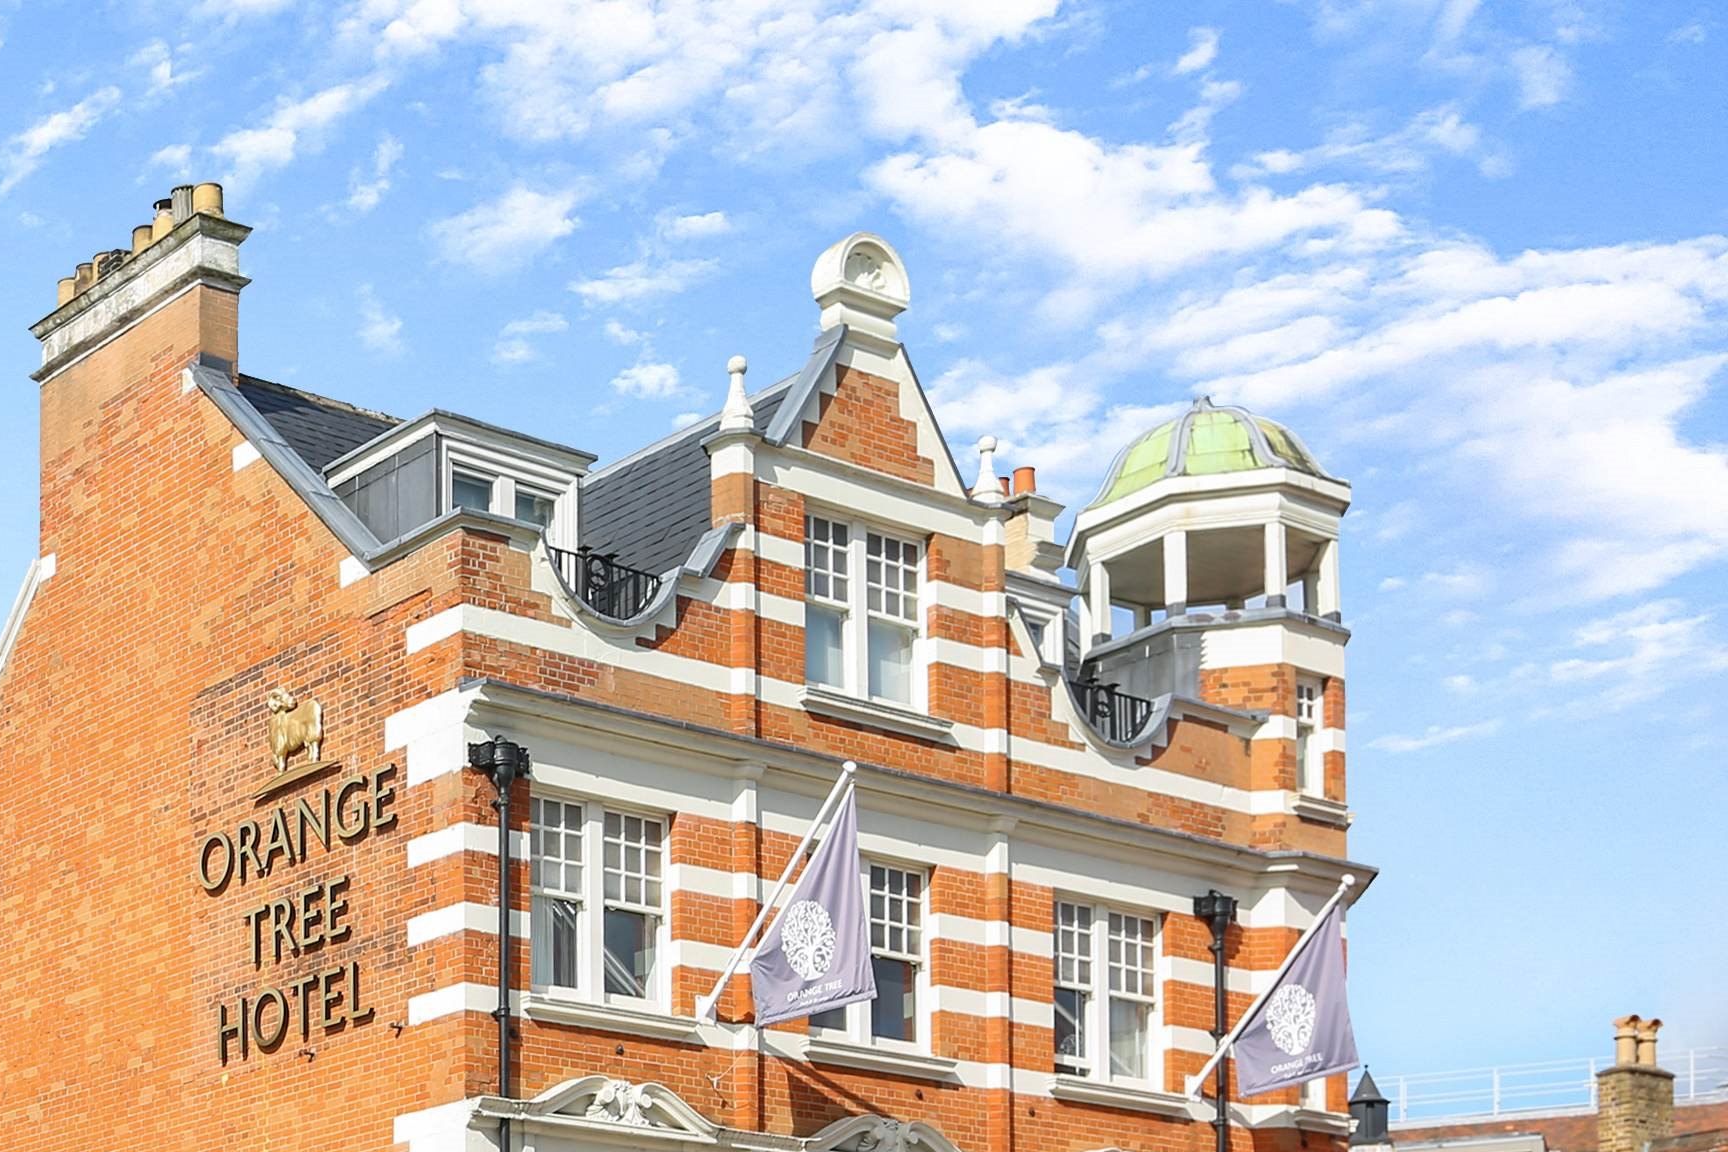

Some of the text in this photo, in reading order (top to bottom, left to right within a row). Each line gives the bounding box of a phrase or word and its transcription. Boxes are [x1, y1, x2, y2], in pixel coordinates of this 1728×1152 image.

[198, 763, 398, 897] ORANGE
[243, 875, 351, 971] TREE
[216, 961, 375, 1066] HOTEL
